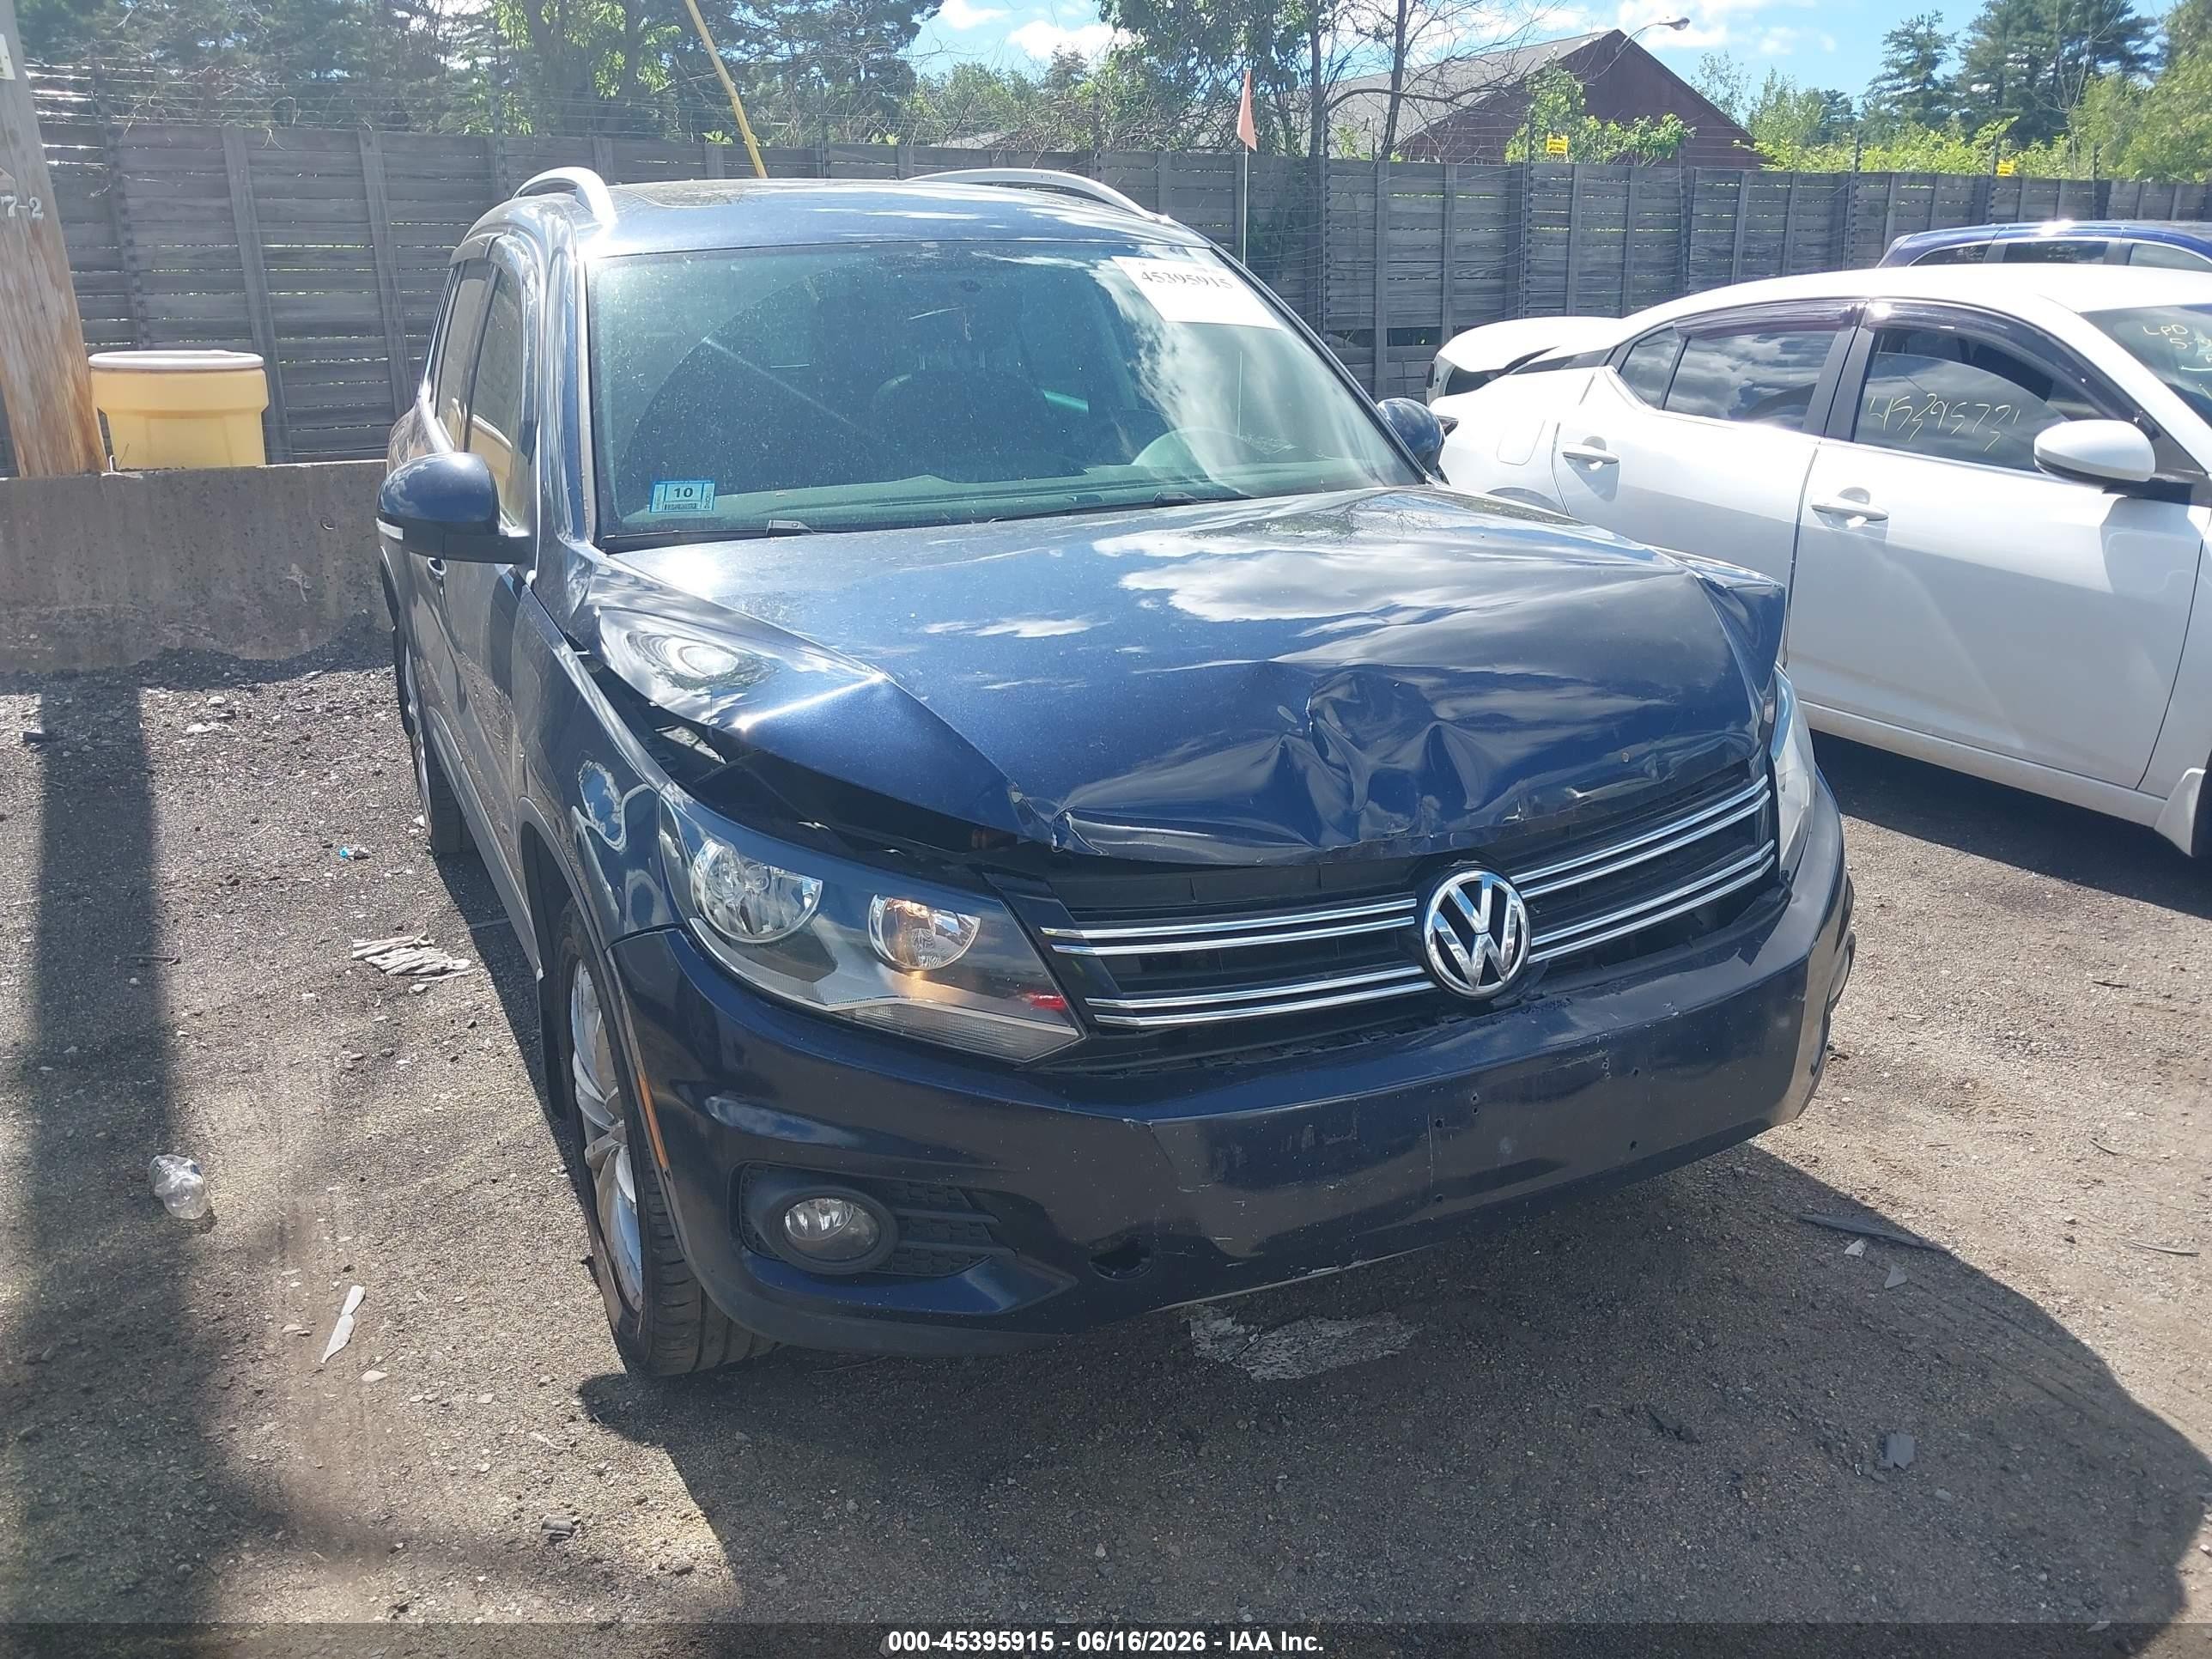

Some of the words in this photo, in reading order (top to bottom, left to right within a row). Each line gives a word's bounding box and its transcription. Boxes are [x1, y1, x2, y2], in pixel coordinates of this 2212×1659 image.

[1140, 270, 1234, 289] 45395915
[673, 487, 694, 498] 10
[1426, 873, 1526, 992] VW
